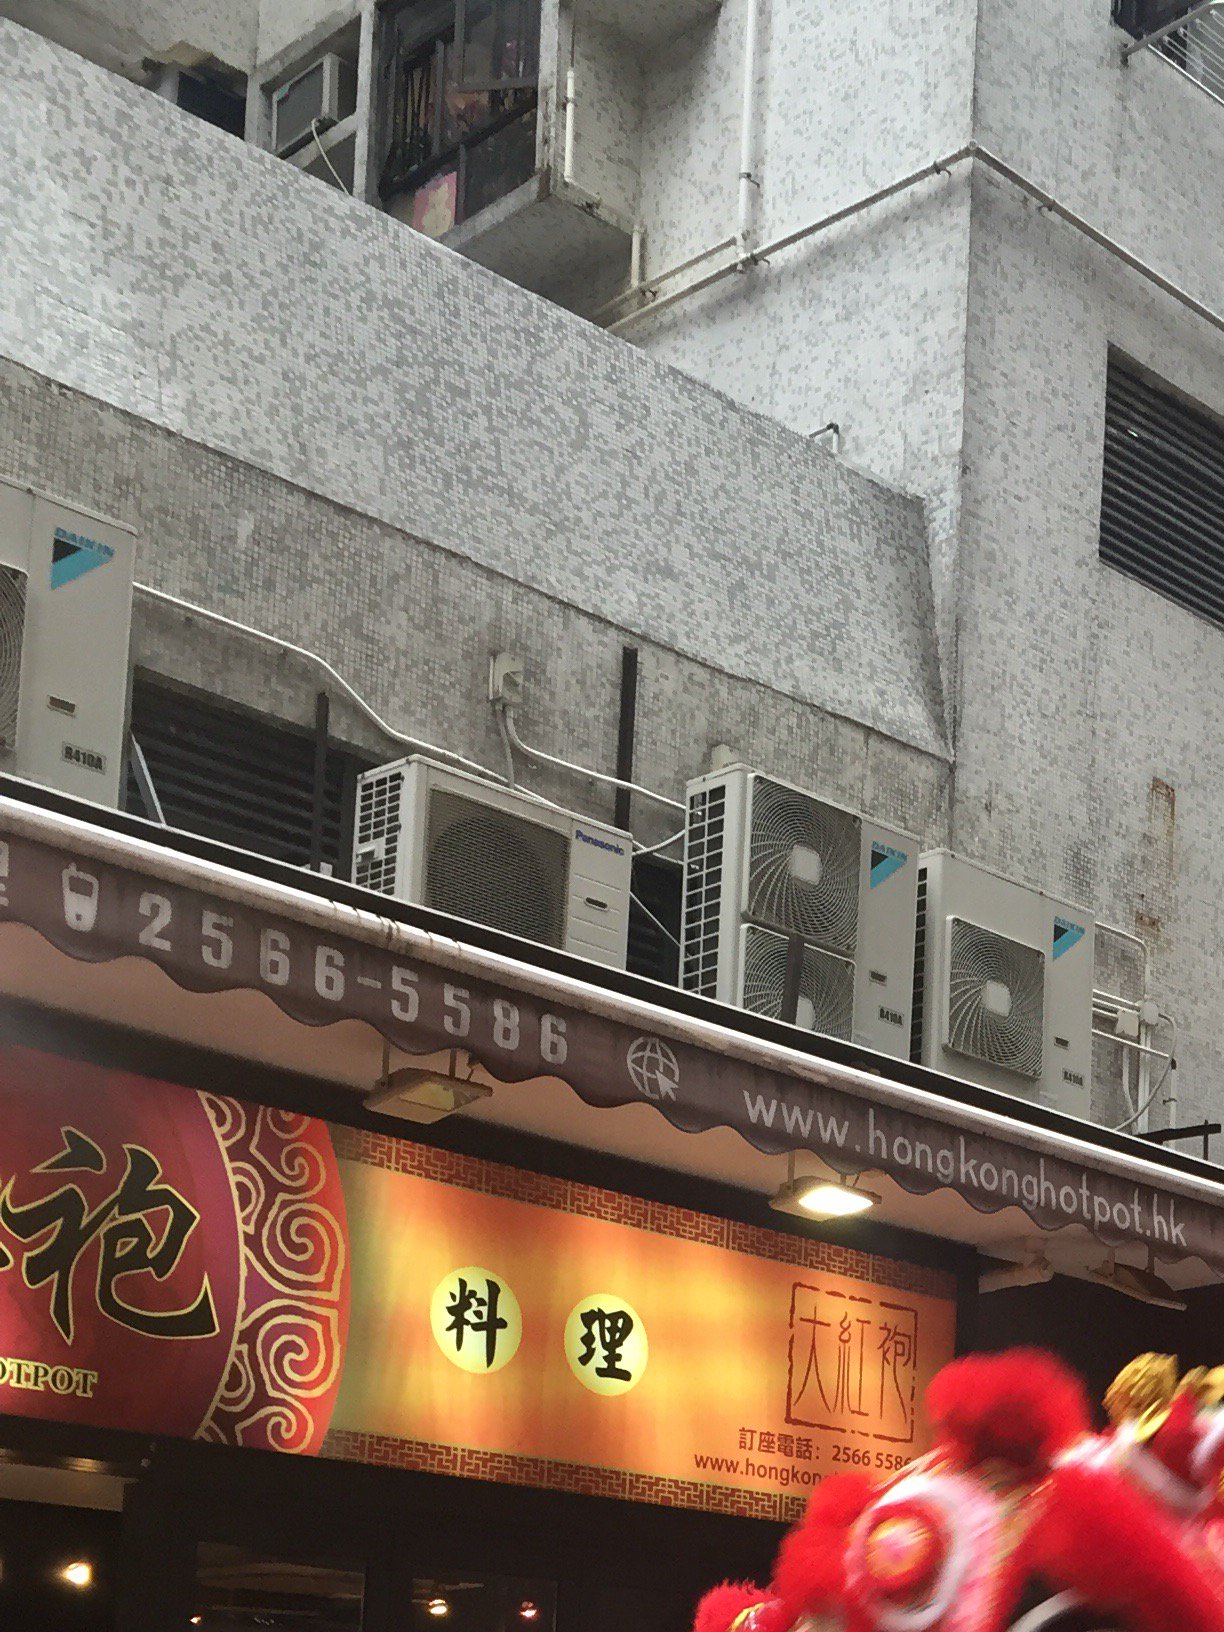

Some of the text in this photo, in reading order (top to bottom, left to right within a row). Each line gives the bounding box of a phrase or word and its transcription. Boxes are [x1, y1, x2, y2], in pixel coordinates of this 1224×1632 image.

[575, 829, 625, 856] Panasonic
[137, 891, 568, 1067] 2566-5586
[743, 1088, 1188, 1248] www.hongkonghotpot.hk
[792, 1305, 913, 1425] 大紅袍
[694, 1453, 823, 1486] www.hongkon
[832, 1445, 871, 1466] 2566
